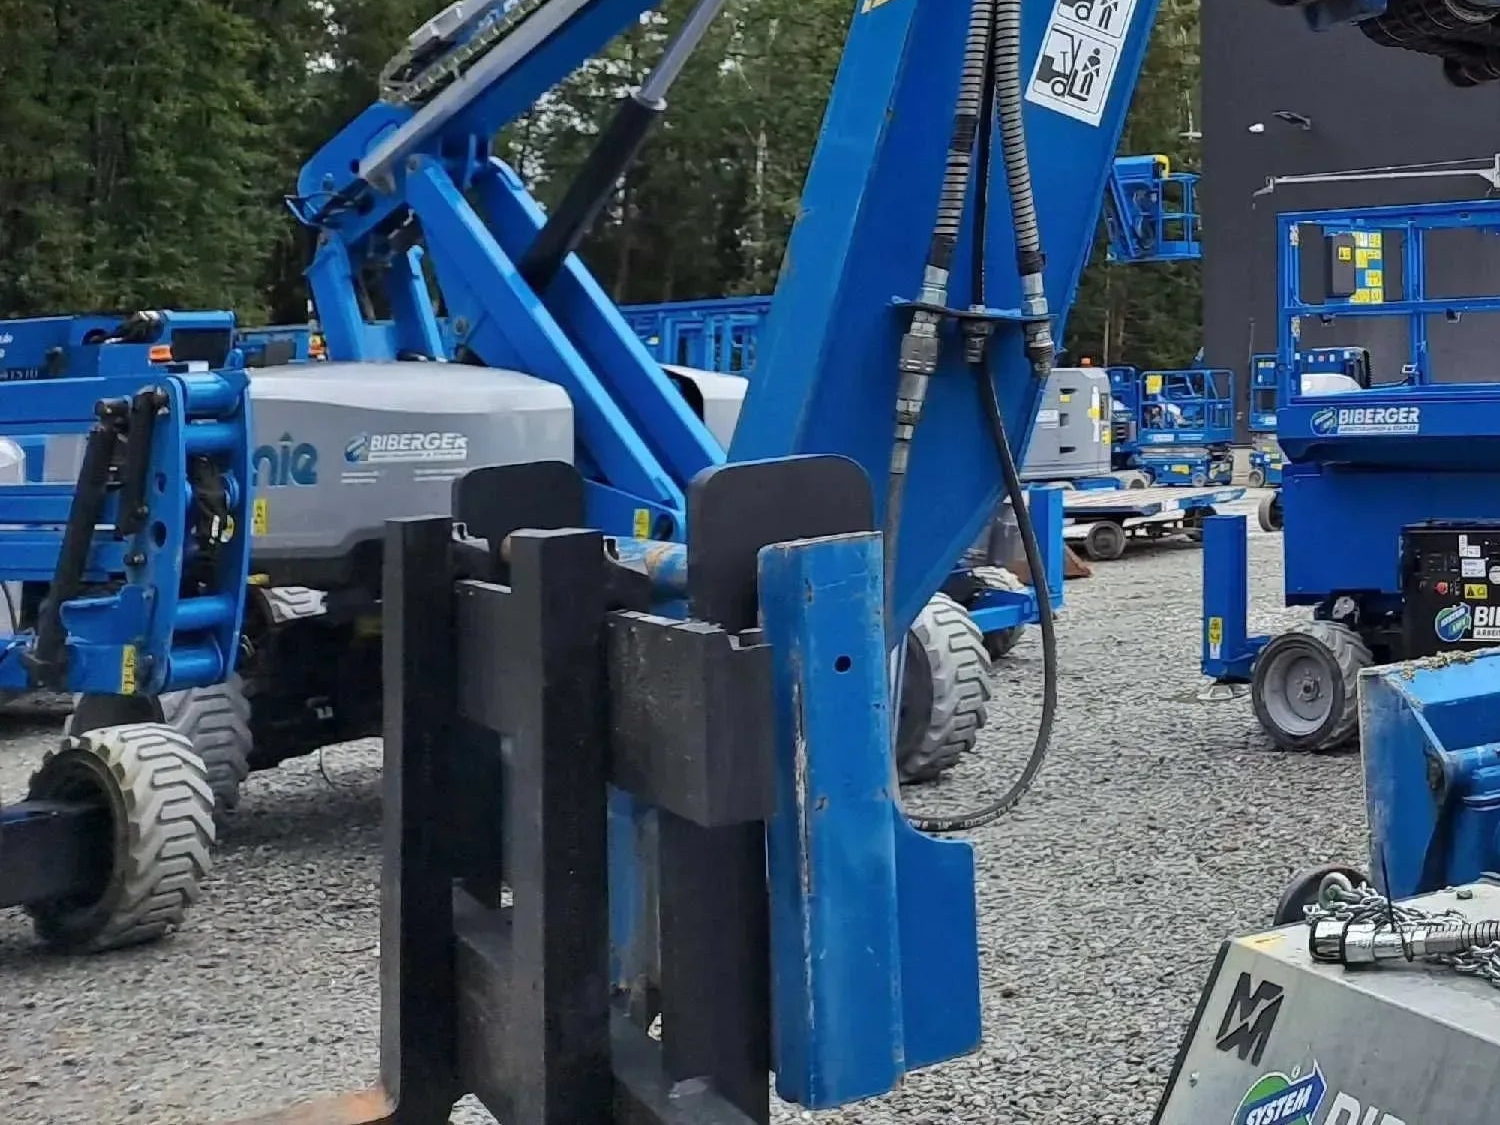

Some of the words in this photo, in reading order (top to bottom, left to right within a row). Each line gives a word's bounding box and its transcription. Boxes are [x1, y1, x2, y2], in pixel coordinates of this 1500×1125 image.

[1338, 407, 1420, 424] BIBERGER
[370, 432, 468, 452] BIBERGER
[1246, 1082, 1313, 1125] SYSTEM
